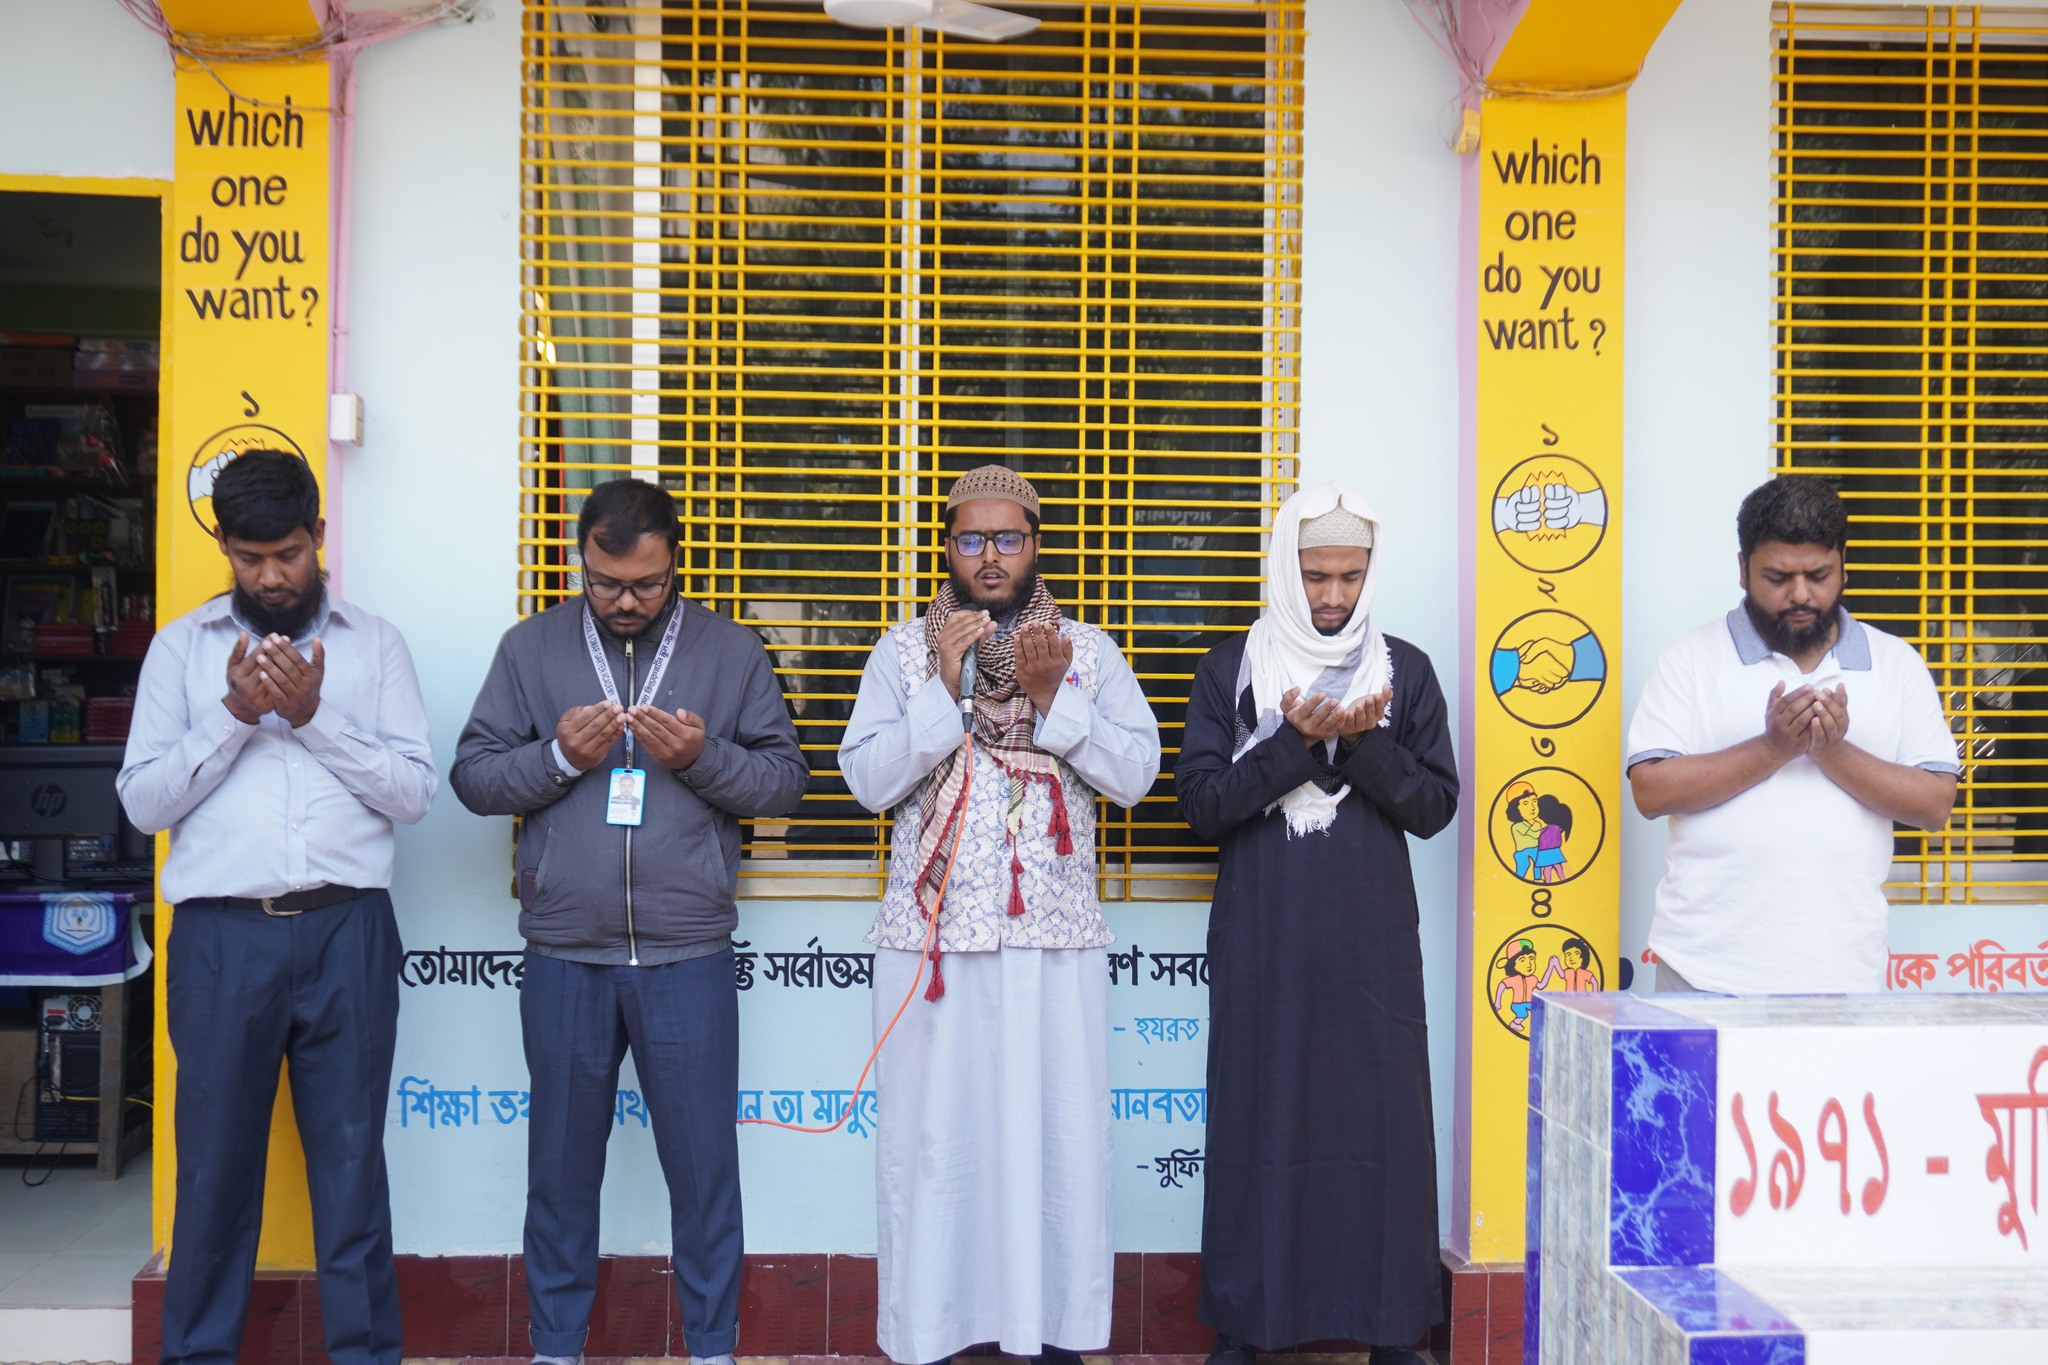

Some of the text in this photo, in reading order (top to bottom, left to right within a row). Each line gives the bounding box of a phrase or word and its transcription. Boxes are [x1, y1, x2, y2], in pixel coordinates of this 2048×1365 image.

[187, 95, 304, 148] which
[1492, 137, 1601, 185] which
[211, 175, 288, 207] one
[1505, 209, 1576, 241] one
[180, 215, 304, 280] do you
[1484, 250, 1601, 311] do you
[589, 637, 600, 653] OMAR
[594, 652, 607, 673] GARTEN
[601, 672, 615, 696] ACADEMY
[396, 1075, 480, 1129] শিক্ষা
[769, 1090, 804, 1125] তা
[1154, 1148, 1205, 1189] সুফি
[1729, 1090, 1890, 1217] ১৯৭১
